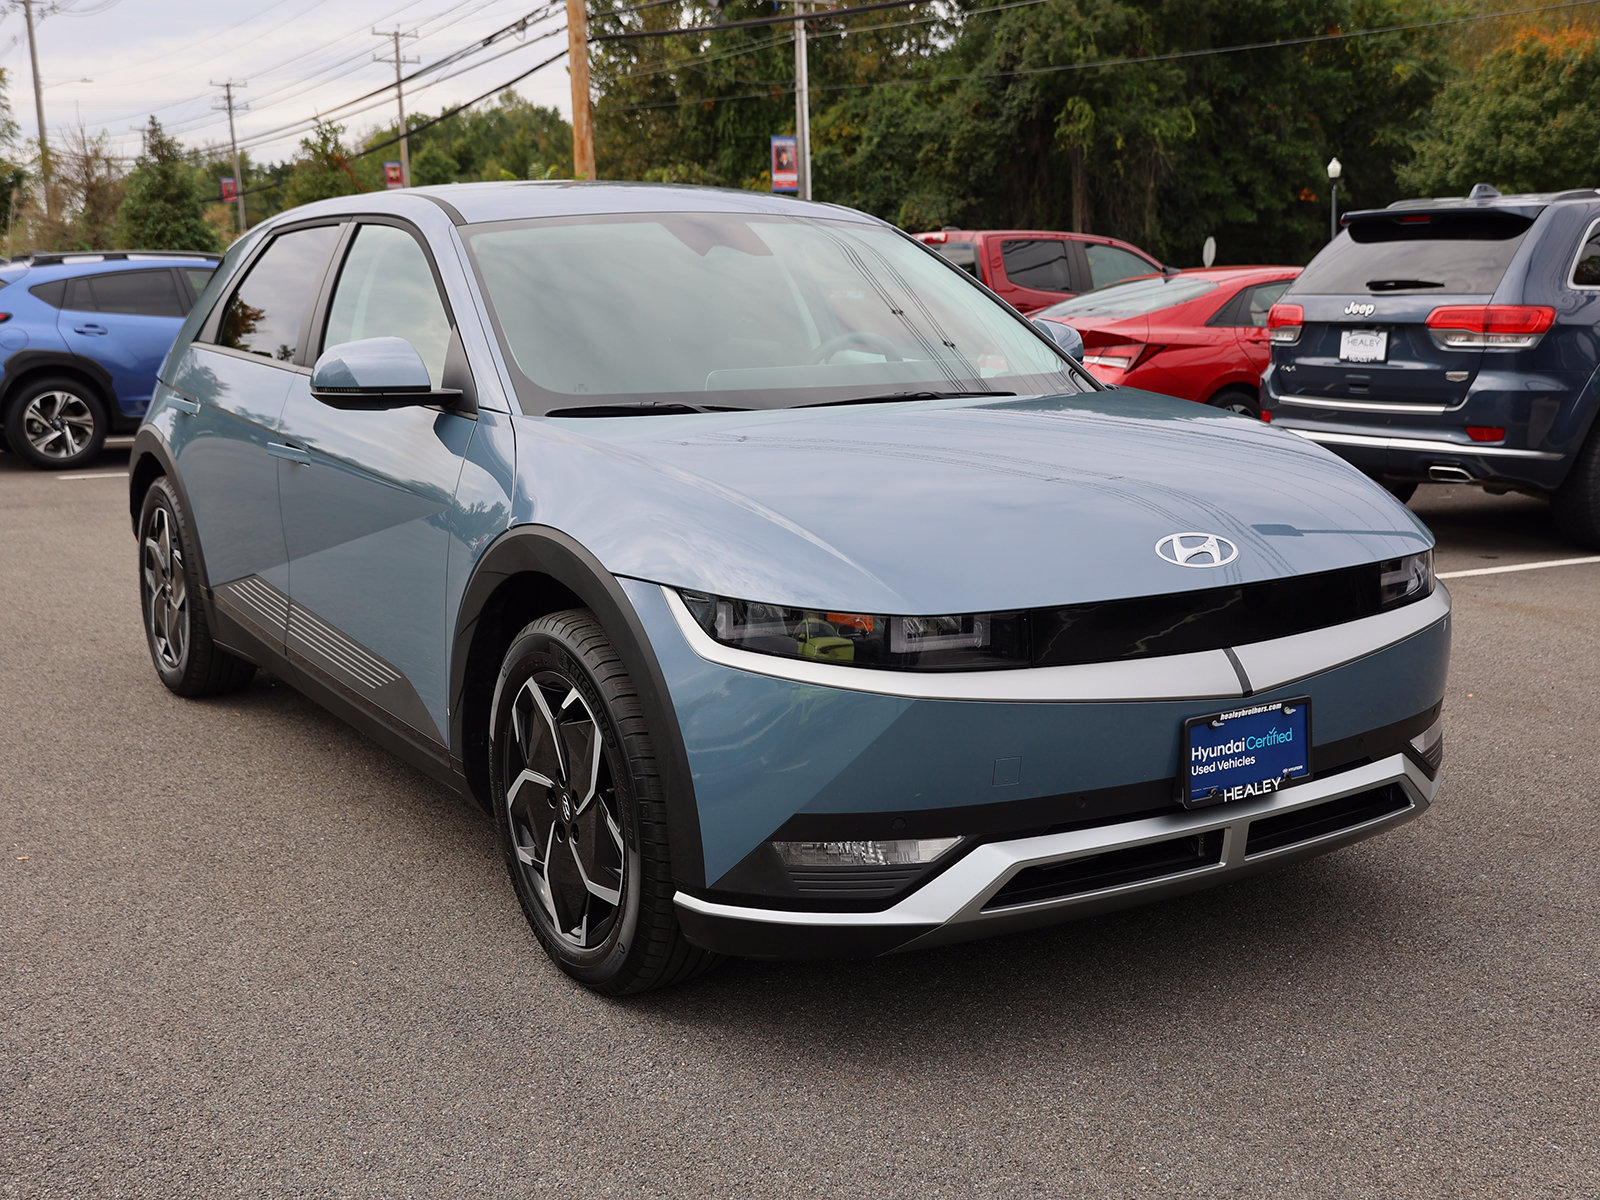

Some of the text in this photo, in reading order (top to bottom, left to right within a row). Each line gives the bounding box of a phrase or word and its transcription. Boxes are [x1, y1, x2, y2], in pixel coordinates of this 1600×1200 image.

[1344, 301, 1375, 318] Jeep
[1347, 338, 1381, 347] HEALEY
[1220, 703, 1282, 721] healeybrothers.com
[1191, 727, 1293, 763] Hyundai Certified
[1191, 755, 1256, 776] Used Vehicles
[1223, 777, 1281, 802] HEALEY
